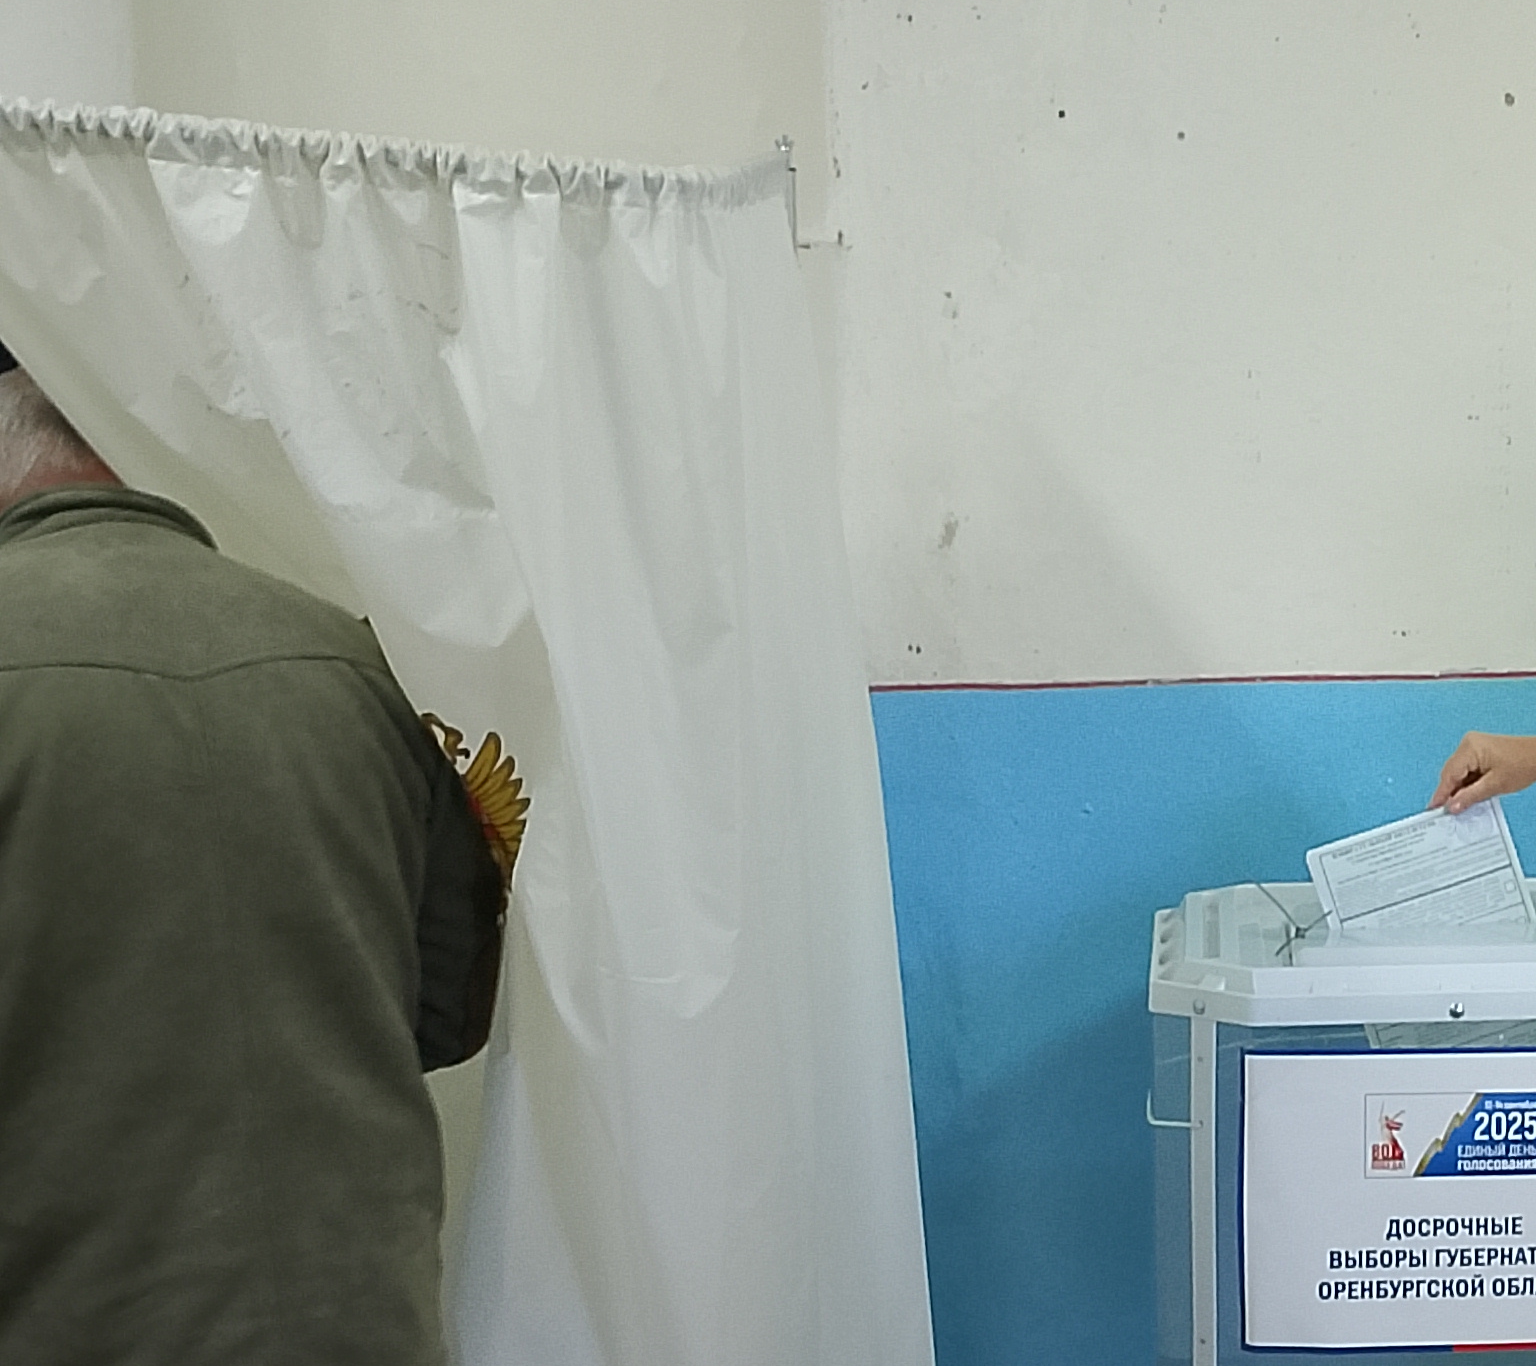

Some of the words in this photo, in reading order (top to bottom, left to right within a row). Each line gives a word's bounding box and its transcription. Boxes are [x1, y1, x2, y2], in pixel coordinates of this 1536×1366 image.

[1457, 1142, 1506, 1157] ЕДИНЫЙ
[1385, 1217, 1523, 1241] ДОСРОЧНЫЕ
[1328, 1248, 1428, 1271] ВЫБОРЫ
[1318, 1275, 1485, 1301] ОРЕНБУРГСКОЙ
